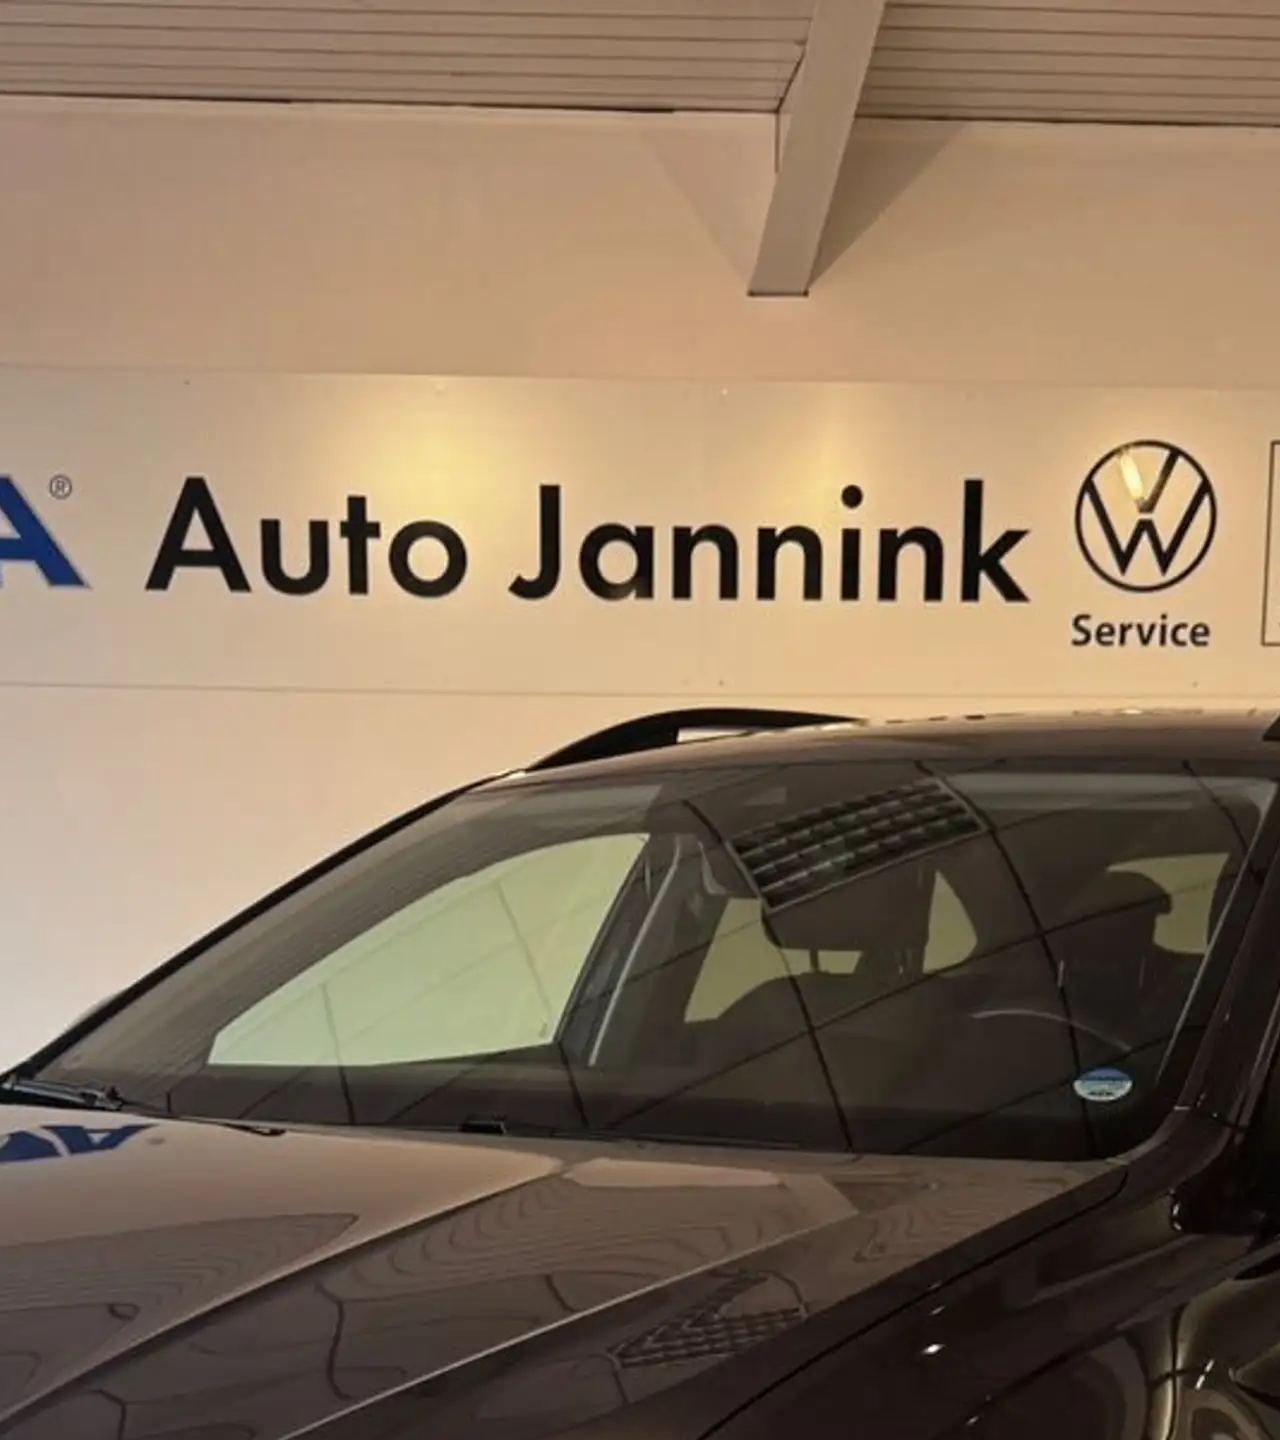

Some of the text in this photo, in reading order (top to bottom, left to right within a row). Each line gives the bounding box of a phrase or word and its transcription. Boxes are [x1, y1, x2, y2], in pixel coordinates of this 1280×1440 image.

[144, 475, 1031, 603] Auto Jannink
[1070, 612, 1212, 648] Service
